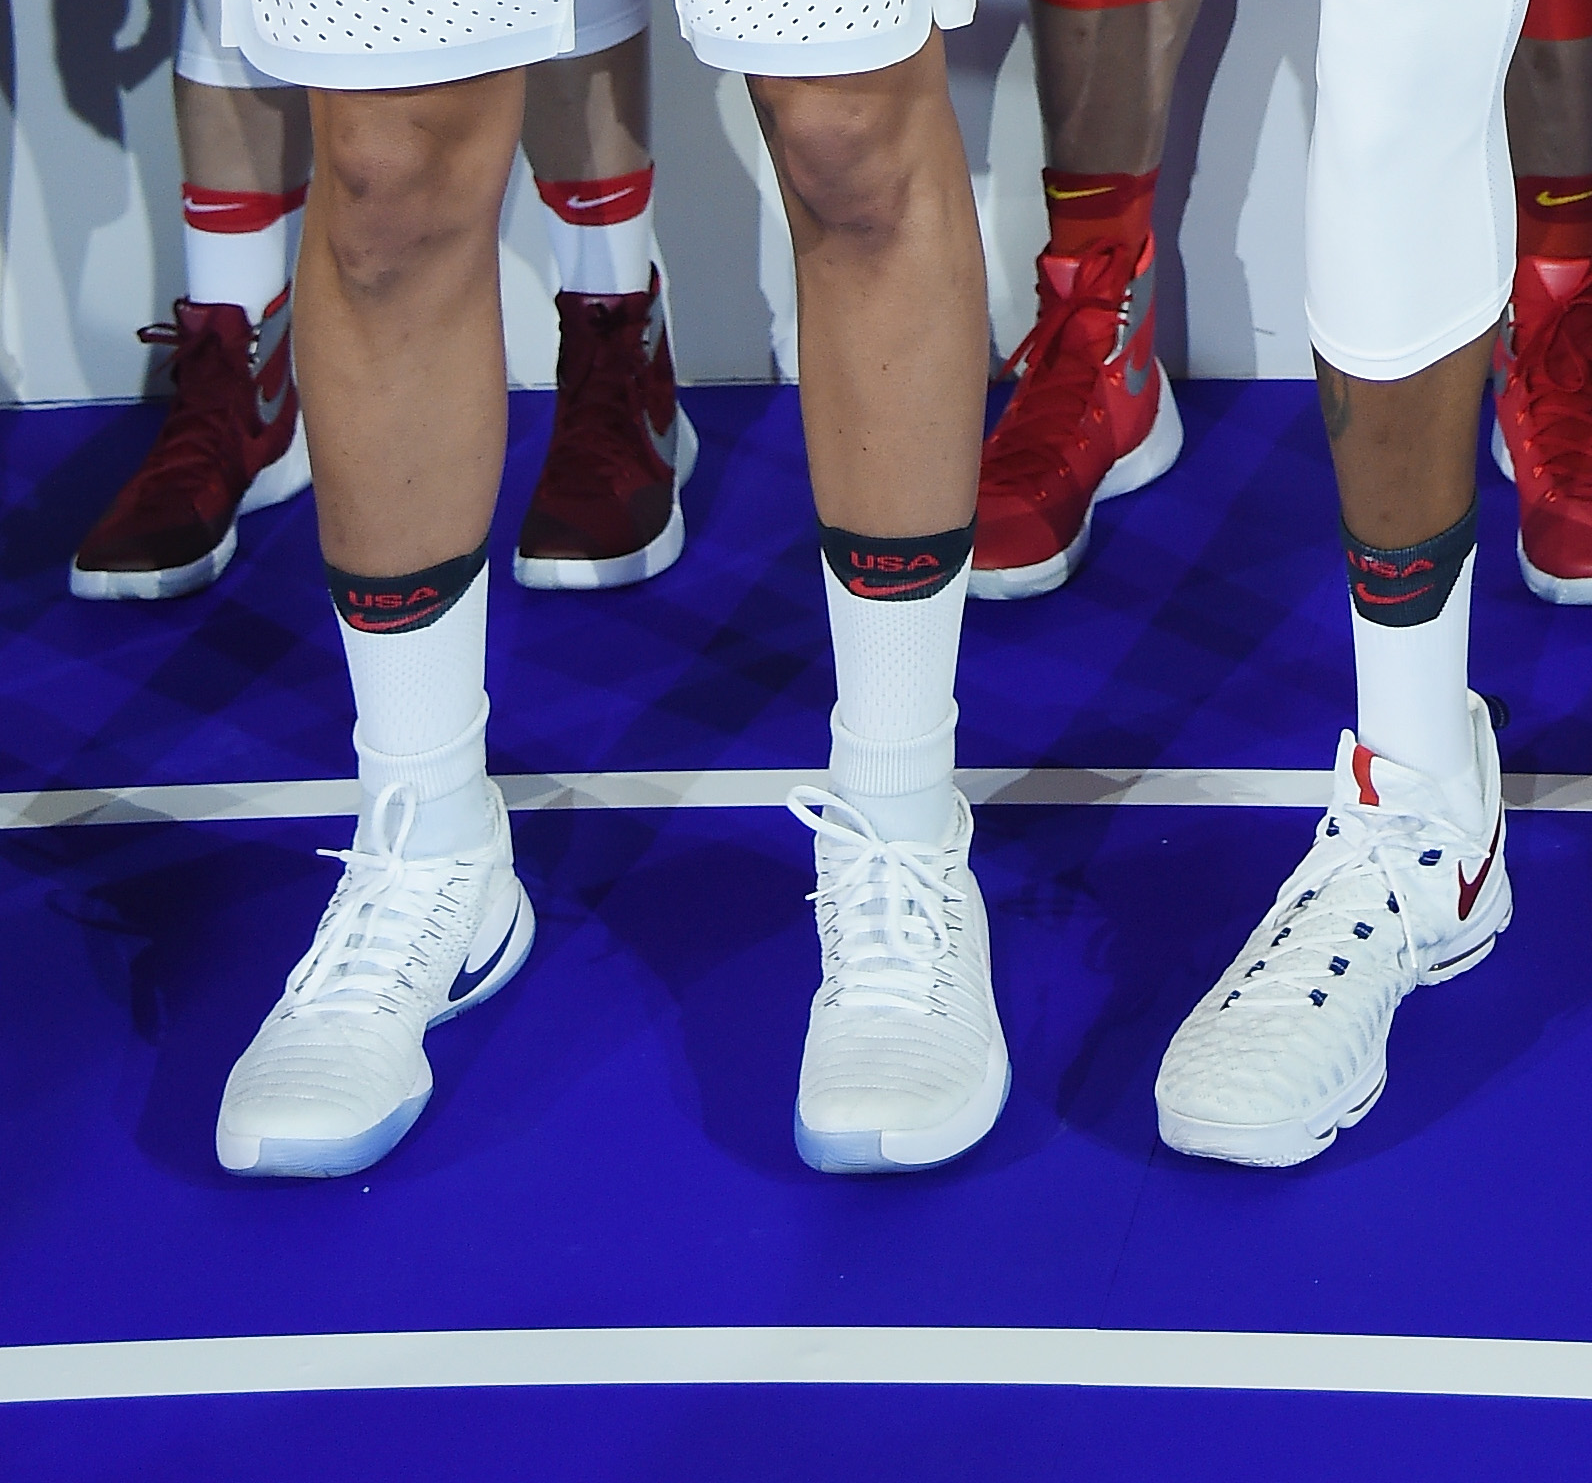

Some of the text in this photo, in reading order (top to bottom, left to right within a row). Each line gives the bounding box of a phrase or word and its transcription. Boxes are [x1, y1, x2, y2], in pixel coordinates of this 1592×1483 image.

[850, 550, 940, 572] USA
[1347, 549, 1435, 579] USA
[348, 586, 439, 609] USA
